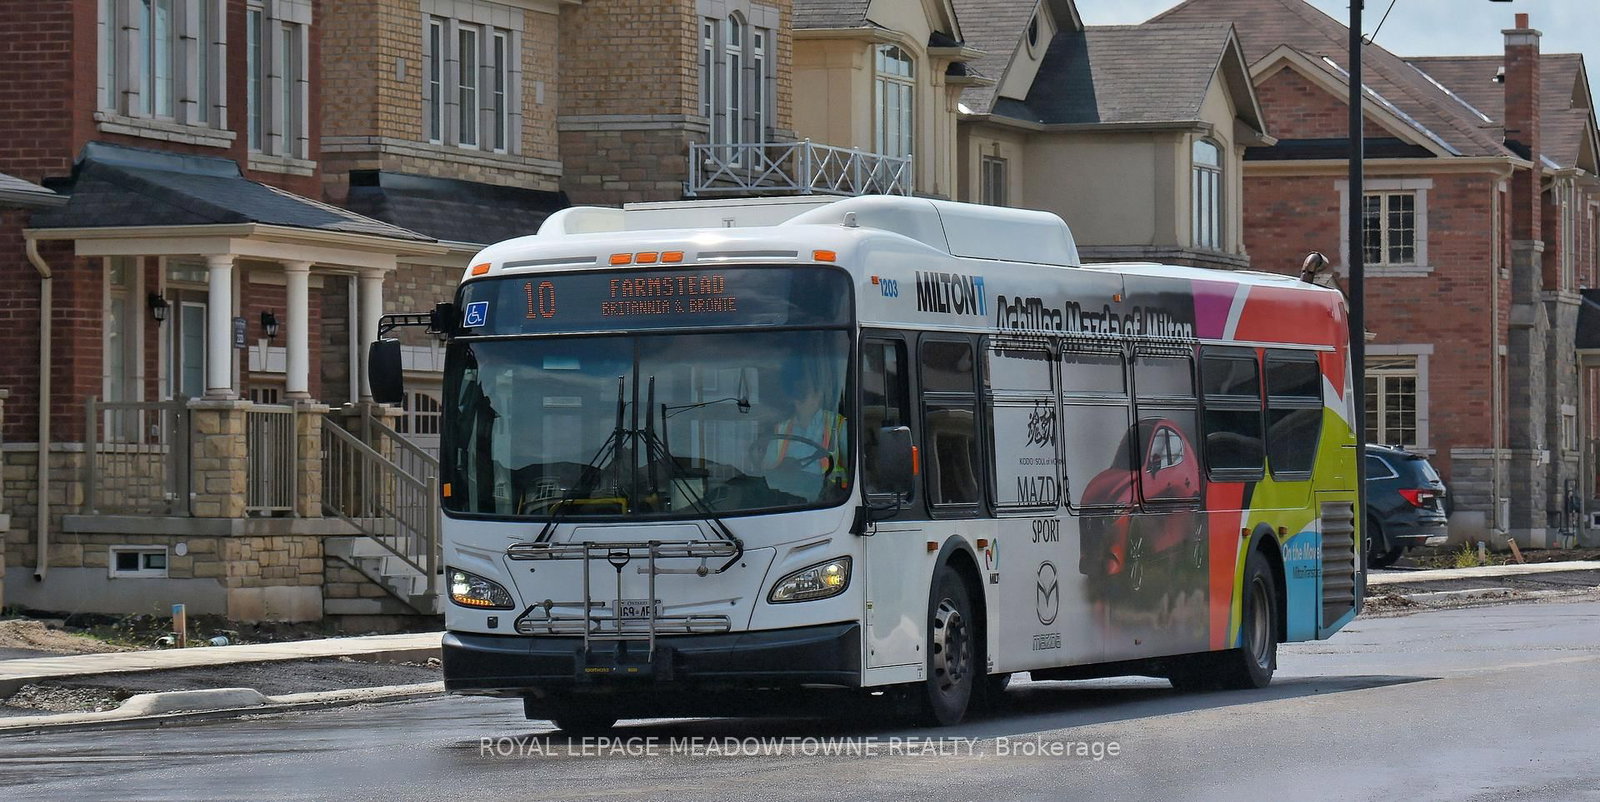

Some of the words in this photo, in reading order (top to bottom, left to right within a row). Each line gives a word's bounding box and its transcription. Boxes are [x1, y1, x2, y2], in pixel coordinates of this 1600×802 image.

[609, 275, 725, 297] FARMSTEAD
[879, 279, 898, 298] 1203
[524, 281, 556, 318] 10
[601, 300, 670, 316] BRITANNIA
[674, 300, 685, 313] &
[690, 297, 737, 313] BRONTE
[1032, 519, 1060, 543] SPORT
